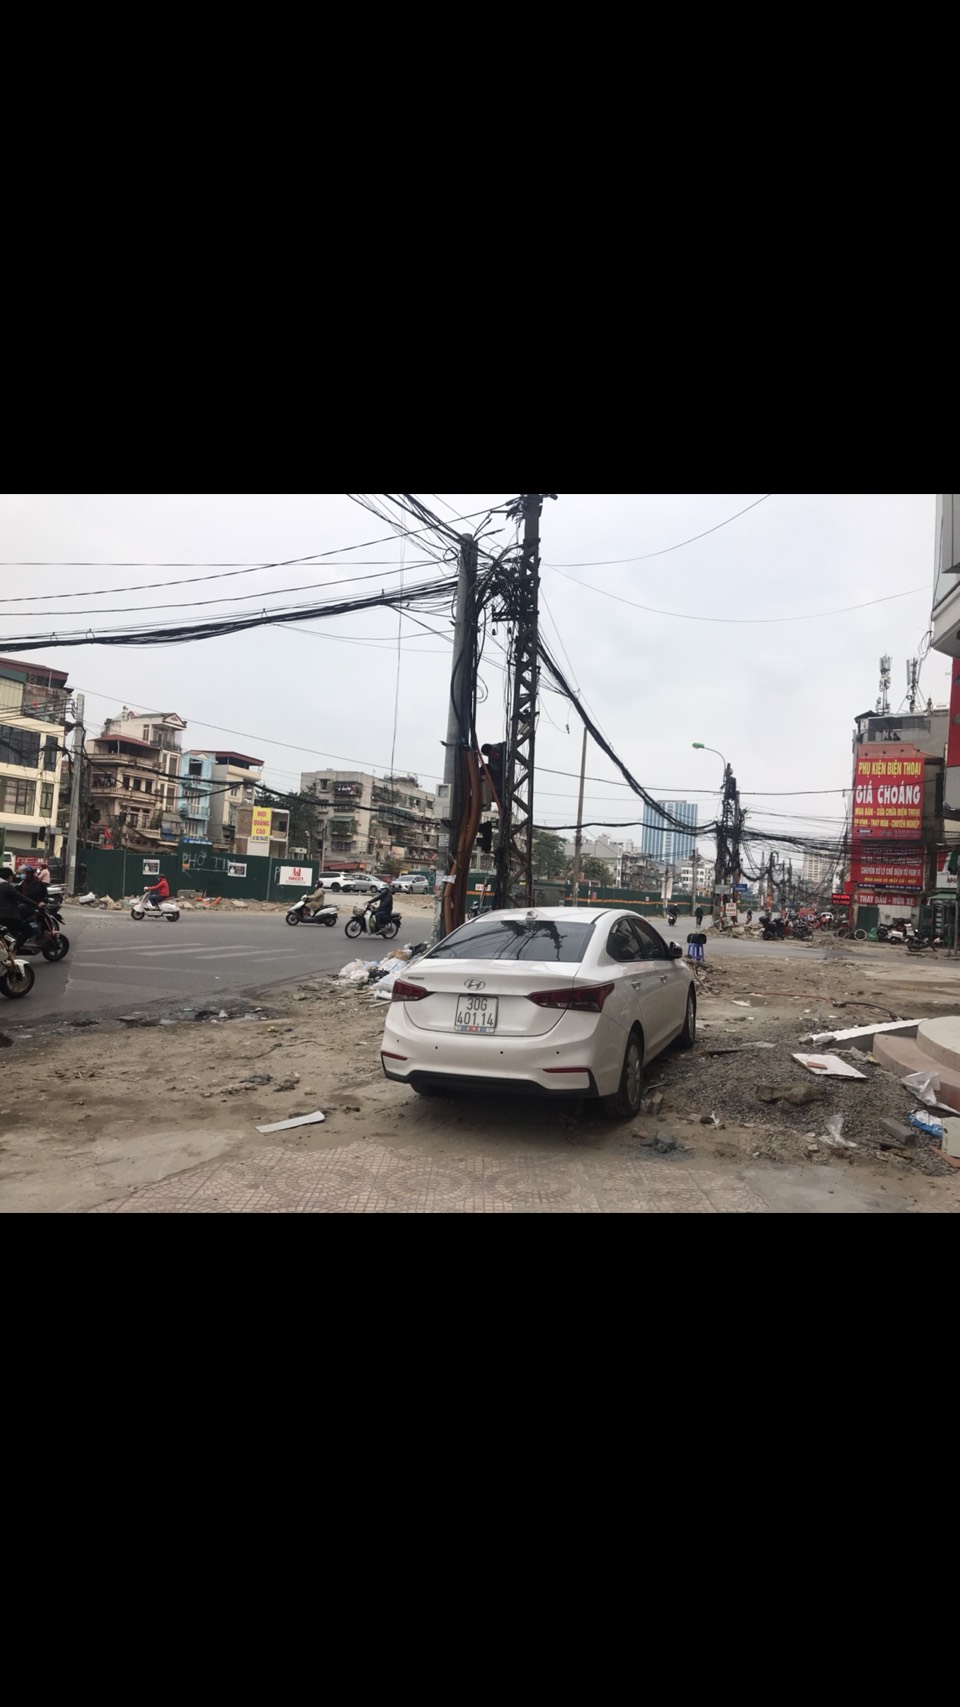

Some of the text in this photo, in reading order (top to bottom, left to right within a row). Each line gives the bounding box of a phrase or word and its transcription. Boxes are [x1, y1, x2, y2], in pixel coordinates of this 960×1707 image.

[858, 759, 922, 779] PHỤ KIỆN ĐIỆN THOẠI
[856, 780, 921, 805] GIÁ CHOÁNG
[860, 895, 874, 904] THAY
[892, 894, 904, 905] RỬA
[906, 898, 914, 906] XE
[466, 997, 488, 1011] 30G
[456, 1011, 494, 1027] 401.14
